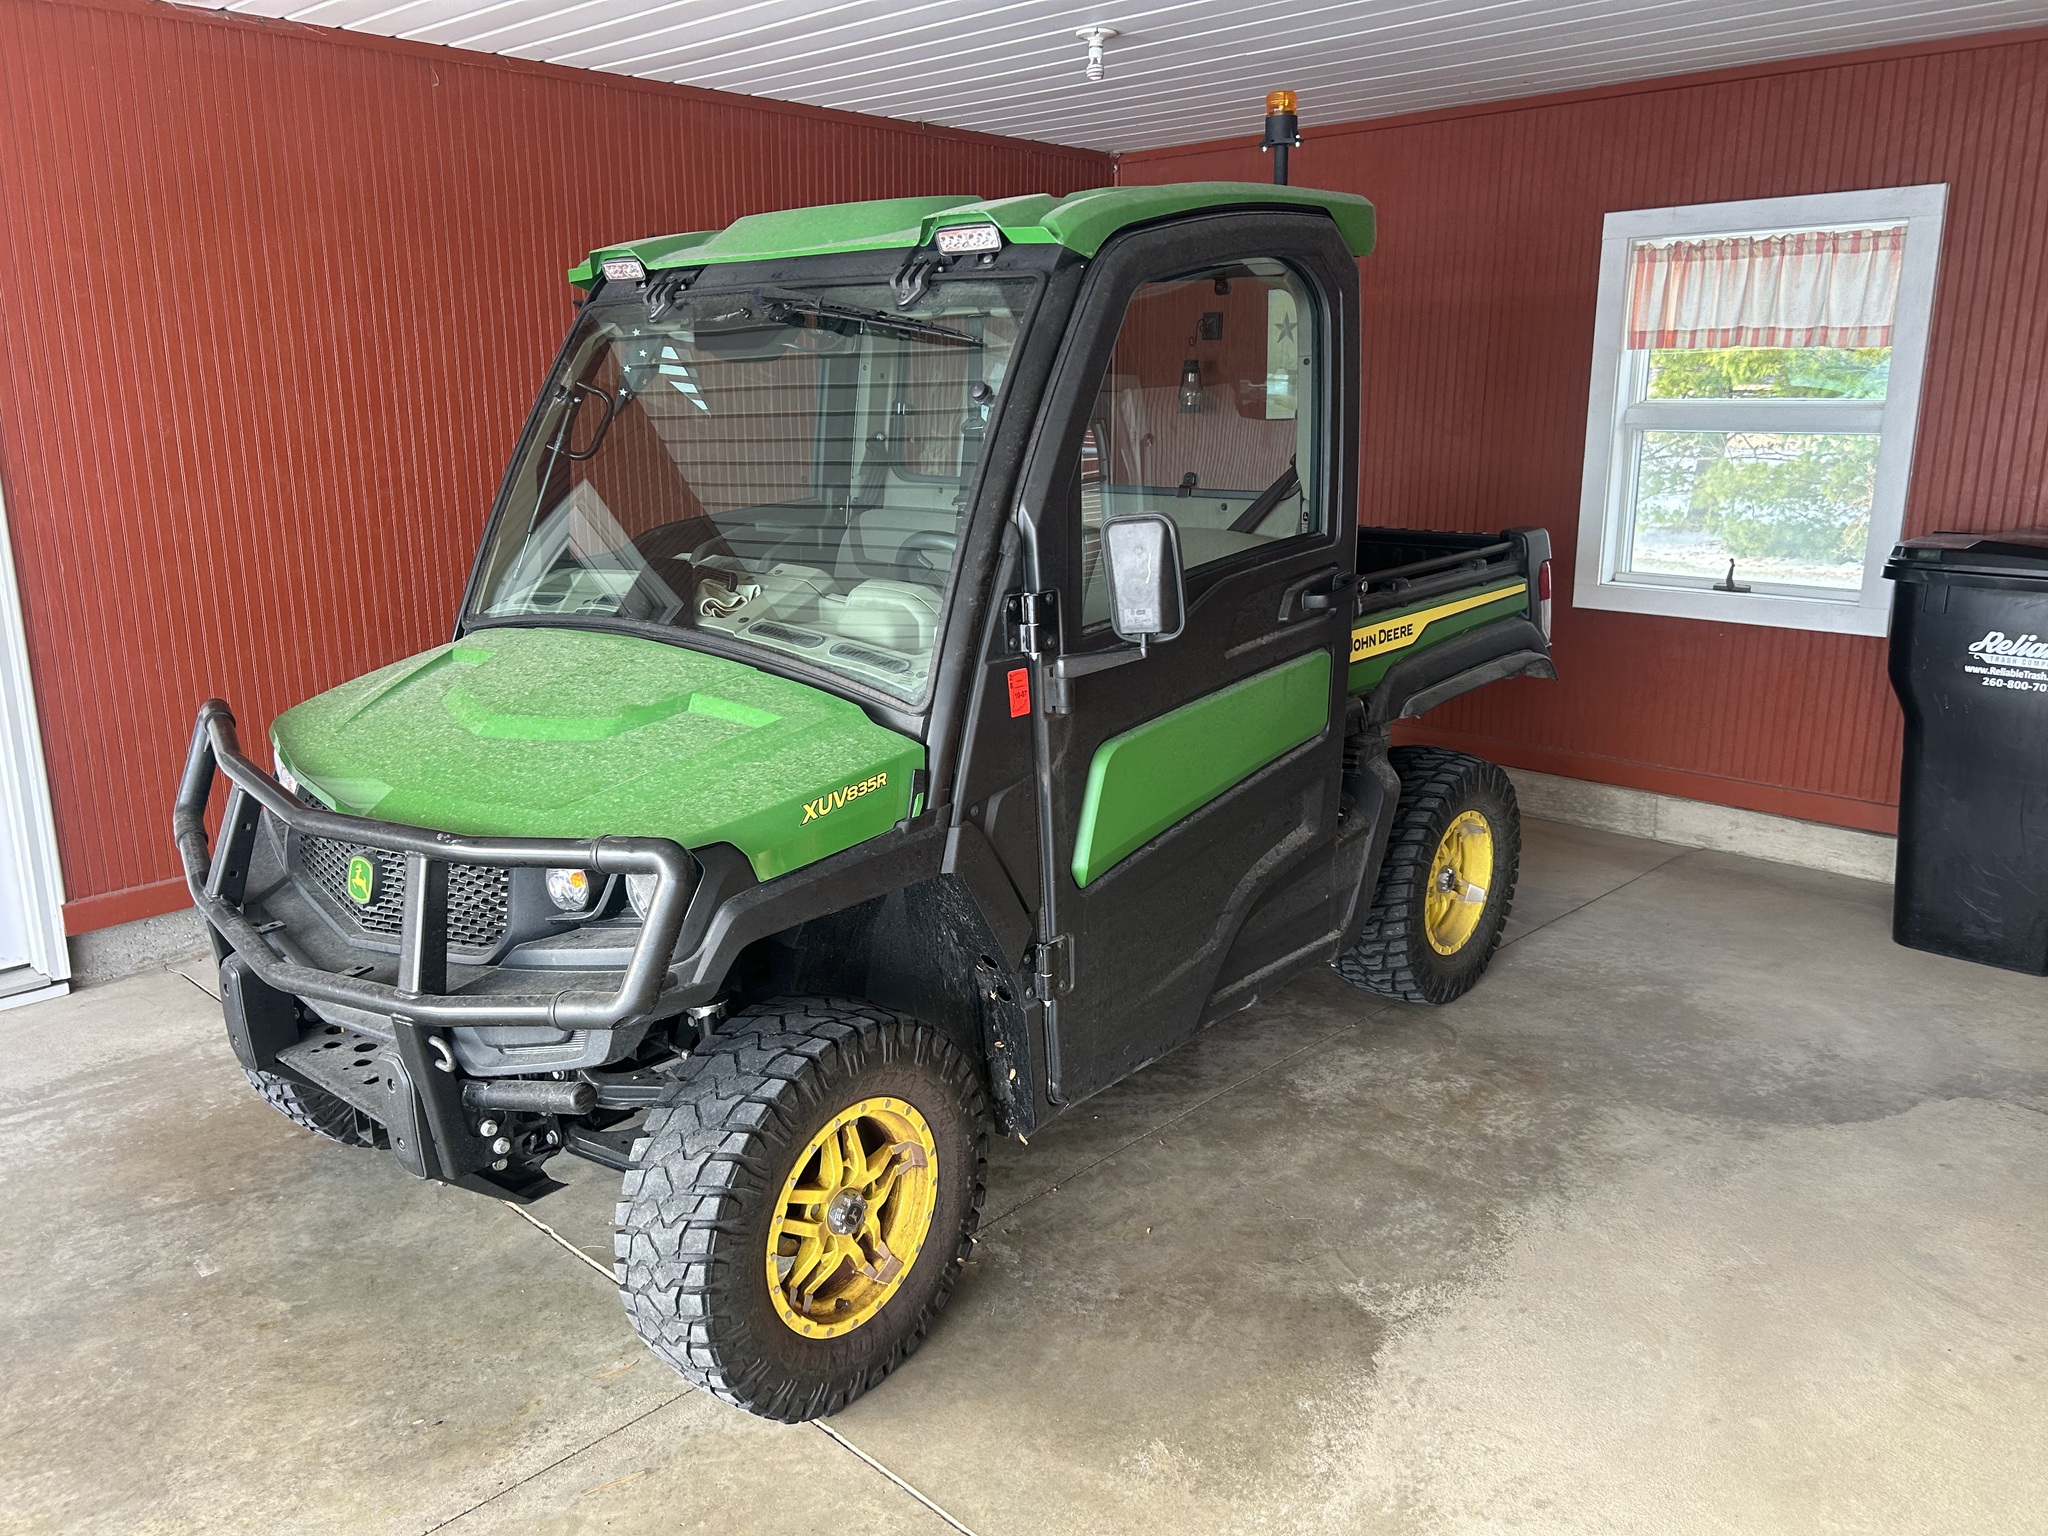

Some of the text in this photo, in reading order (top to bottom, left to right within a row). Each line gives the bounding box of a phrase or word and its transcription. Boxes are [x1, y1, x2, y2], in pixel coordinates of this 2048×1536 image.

[1378, 623, 1413, 644] DEERE
[1968, 631, 2048, 658] Relia
[1990, 656, 2048, 667] TRASH COMP
[800, 772, 887, 826] XUV835R
